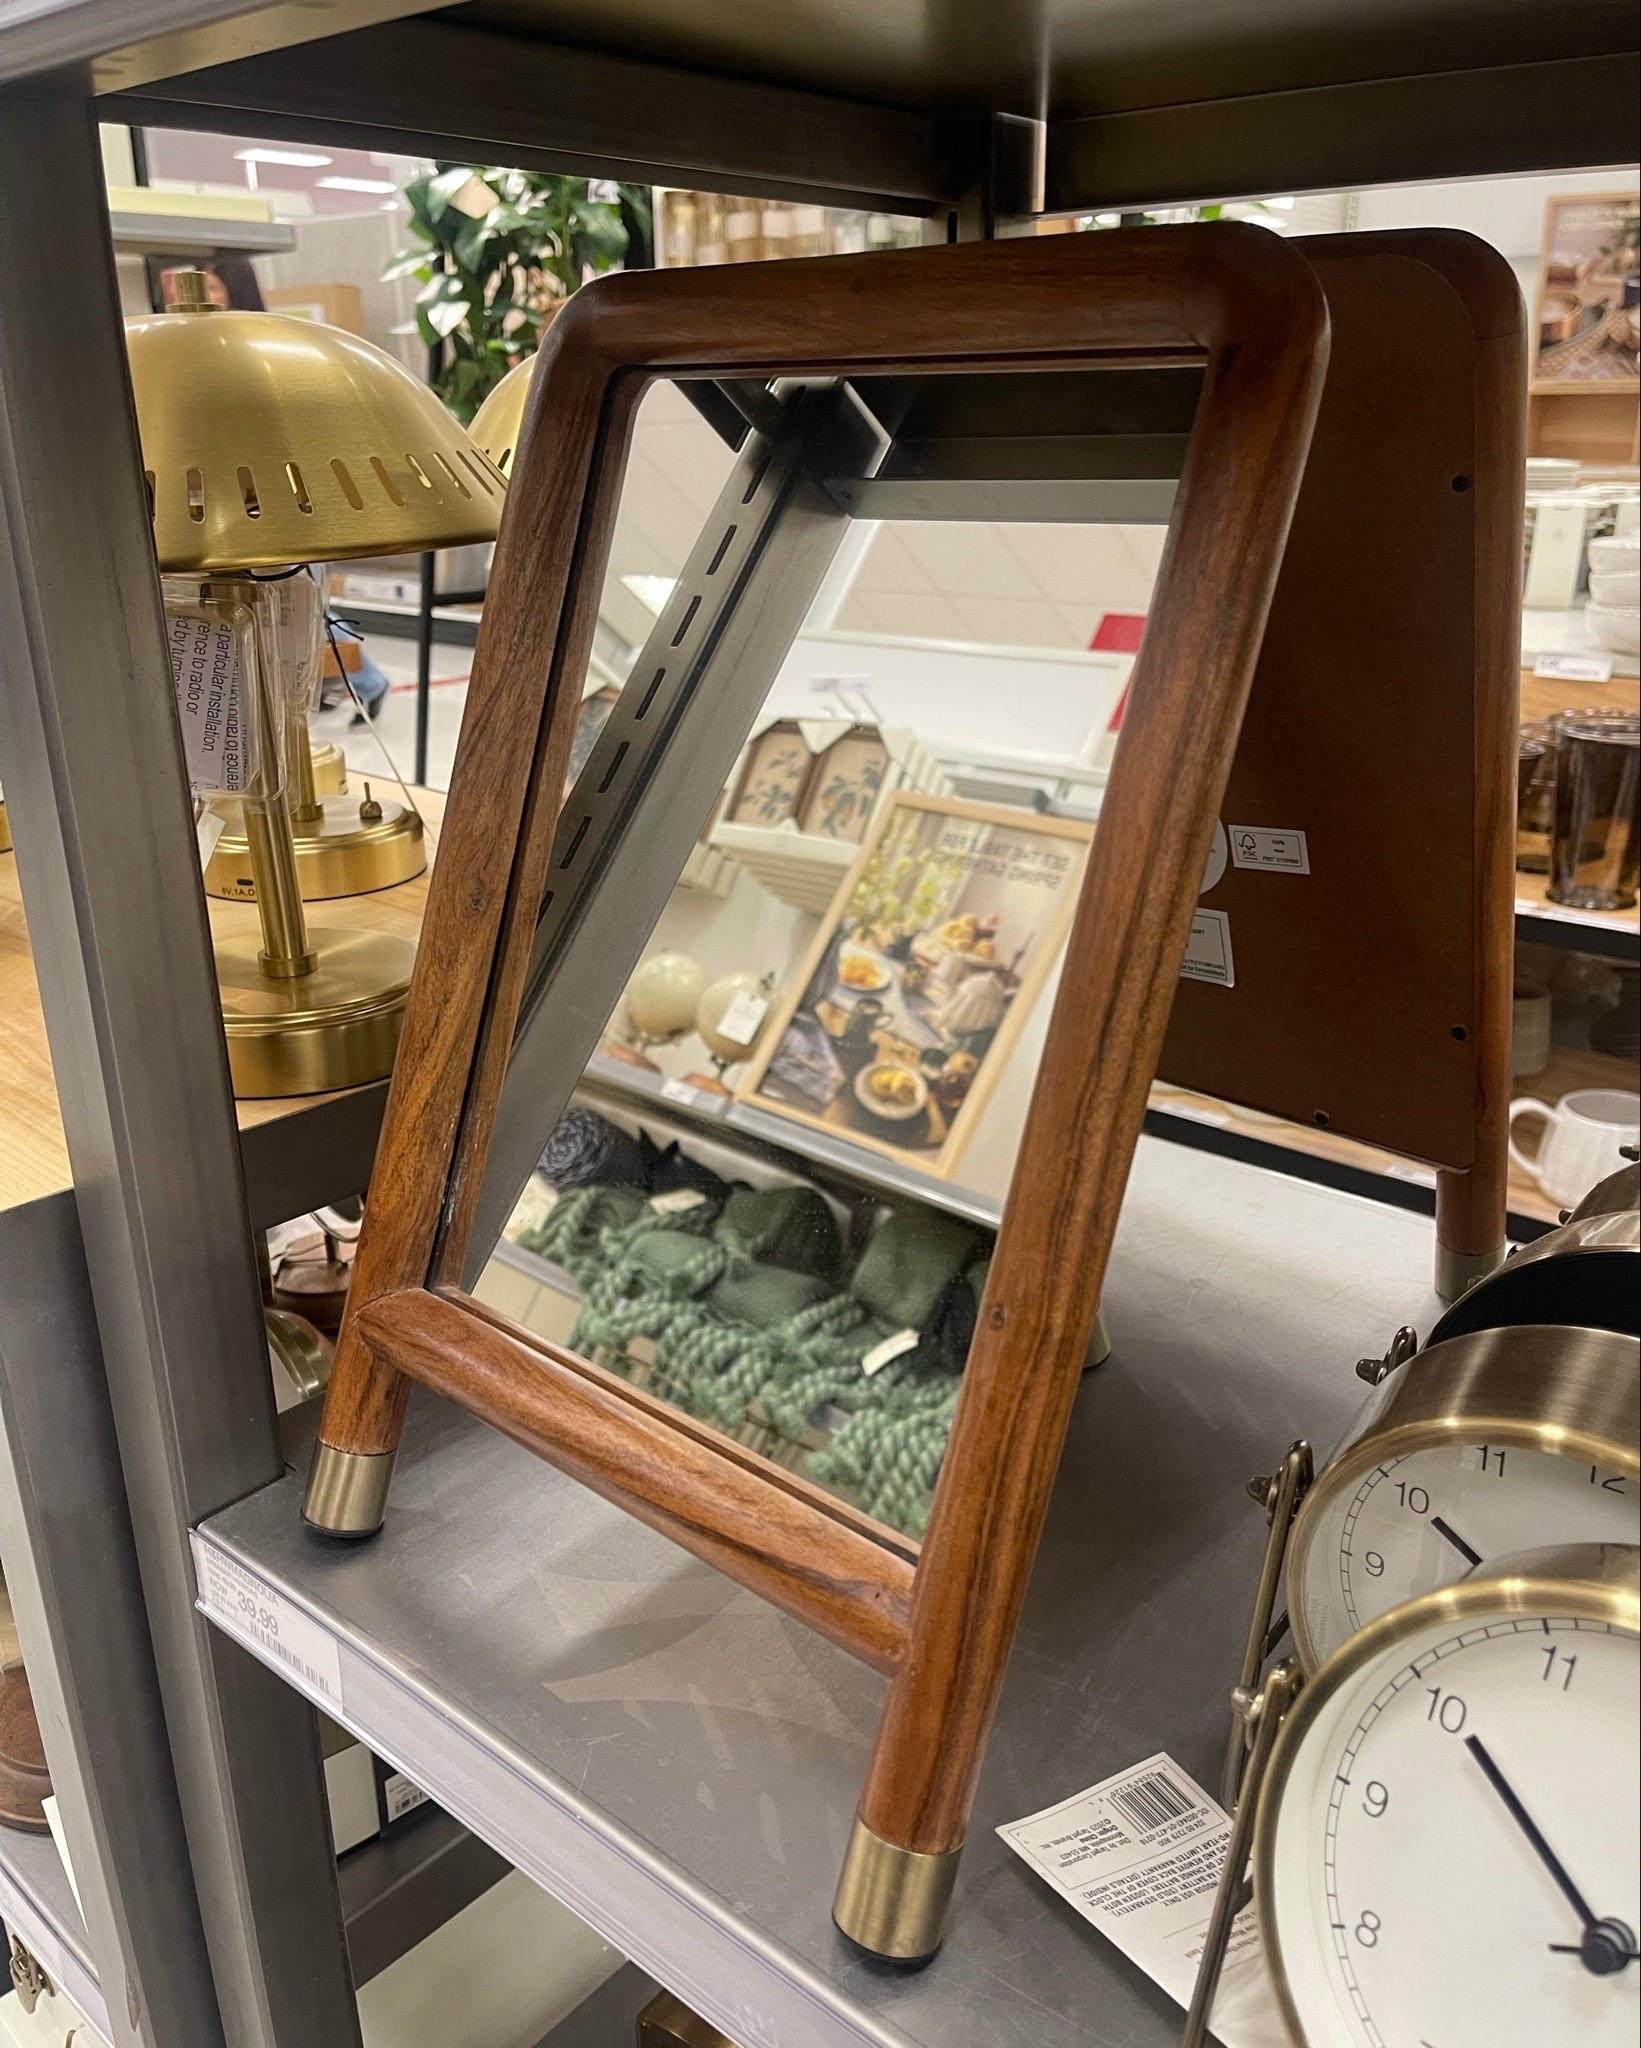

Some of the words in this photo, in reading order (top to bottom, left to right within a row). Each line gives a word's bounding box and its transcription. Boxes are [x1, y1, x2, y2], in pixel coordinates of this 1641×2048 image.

[220, 624, 232, 632] a
[171, 631, 188, 647] by
[192, 658, 207, 669] to
[211, 634, 230, 690] particular
[188, 671, 204, 700] radio
[186, 702, 198, 715] or
[202, 691, 224, 753] installation.
[1476, 1444, 1506, 1477] 11
[1394, 1482, 1430, 1514] 10
[1365, 1551, 1385, 1577] 9
[237, 1591, 279, 1636] 39.99
[1541, 1645, 1577, 1691] 11
[1426, 1687, 1467, 1734] 10
[1362, 1780, 1389, 1818] 9
[1174, 1845, 1204, 1862] LIMITED
[1201, 1849, 1217, 1860] AND
[1139, 1859, 1177, 1876] WARRANTY
[1174, 1856, 1203, 1872] REMOVE
[1177, 1864, 1207, 1880] CHANGE
[1203, 1861, 1216, 1870] OR
[1156, 1867, 1177, 1879] BACK
[1125, 1882, 1137, 1892] OF
[1135, 1875, 1159, 1888] COVER
[1177, 1875, 1207, 1891] BATTERY
[1193, 1879, 1220, 1894] INDOOR
[1110, 1888, 1126, 1898] THE
[1120, 1888, 1150, 1905] LOOSEN
[1178, 1889, 1196, 1899] USE
[1100, 1899, 1123, 1911] BOTH
[1355, 1910, 1381, 1948] 8
